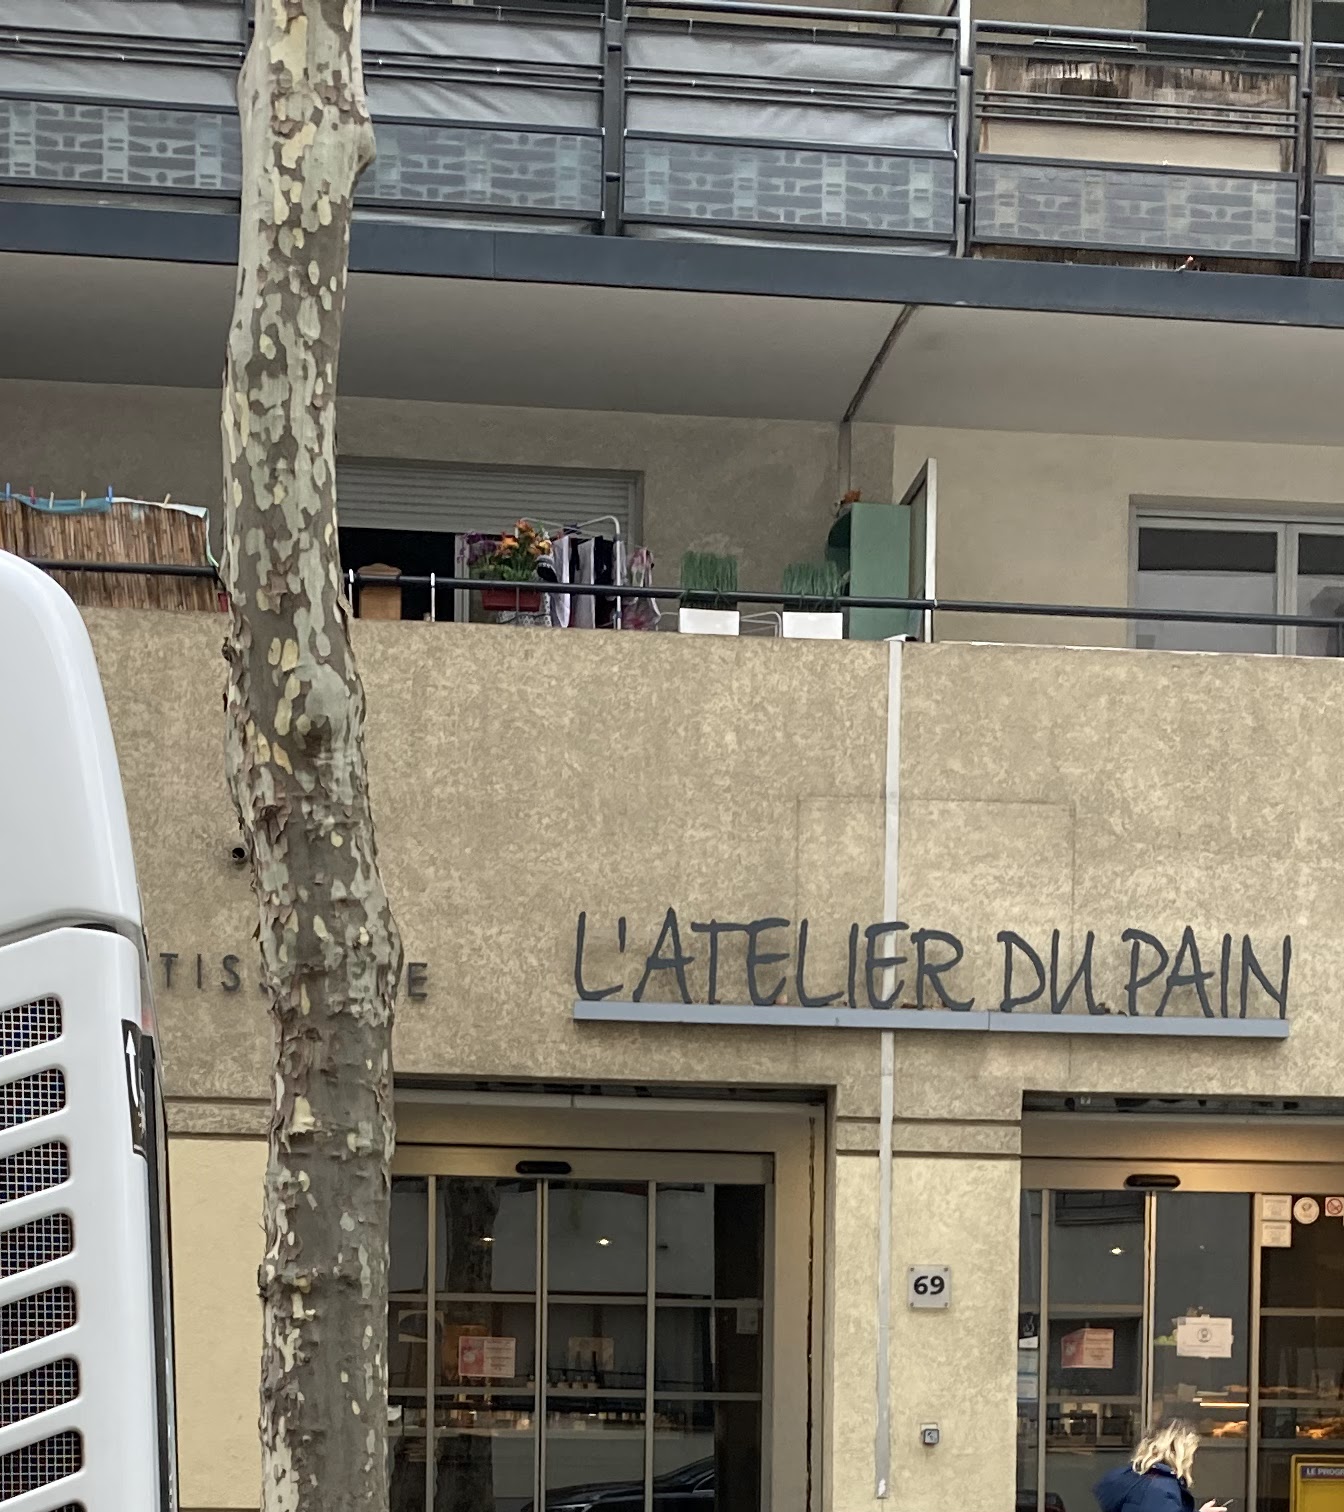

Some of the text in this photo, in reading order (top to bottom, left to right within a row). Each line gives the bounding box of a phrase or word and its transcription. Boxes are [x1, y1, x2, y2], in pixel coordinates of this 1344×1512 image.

[575, 906, 1293, 1020] L'ATELIER DU PAIN
[913, 1275, 945, 1295] 69
[1305, 1467, 1316, 1476] LE
